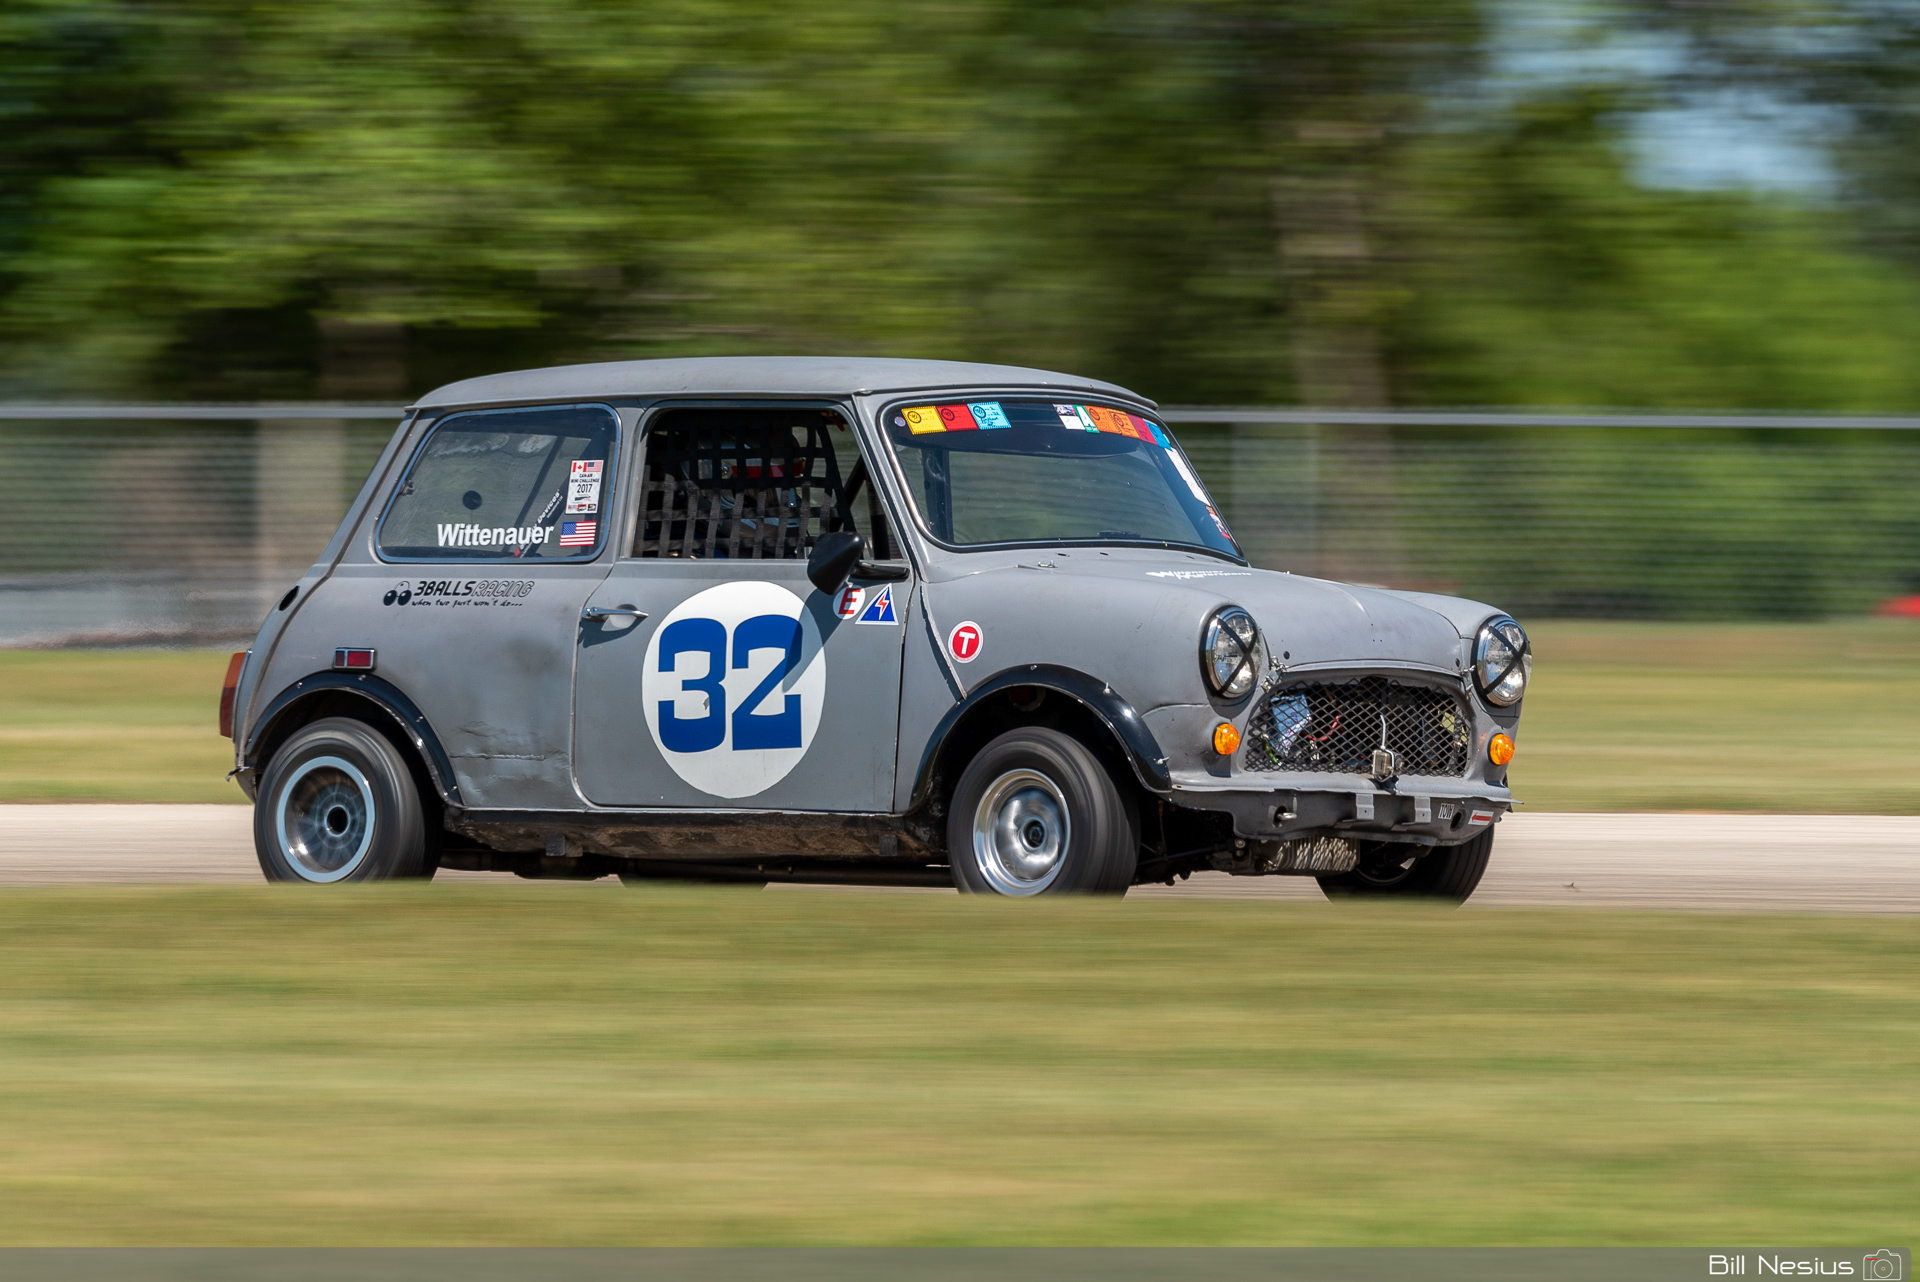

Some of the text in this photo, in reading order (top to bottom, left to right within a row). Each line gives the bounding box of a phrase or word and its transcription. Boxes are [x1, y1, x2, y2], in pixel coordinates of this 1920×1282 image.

[577, 484, 593, 493] 2017
[437, 523, 554, 546] Wittenauer
[411, 598, 431, 606] when
[452, 599, 472, 608] just
[473, 597, 498, 606] won't
[838, 587, 861, 615] E
[958, 631, 976, 655] T
[658, 614, 803, 753] 32
